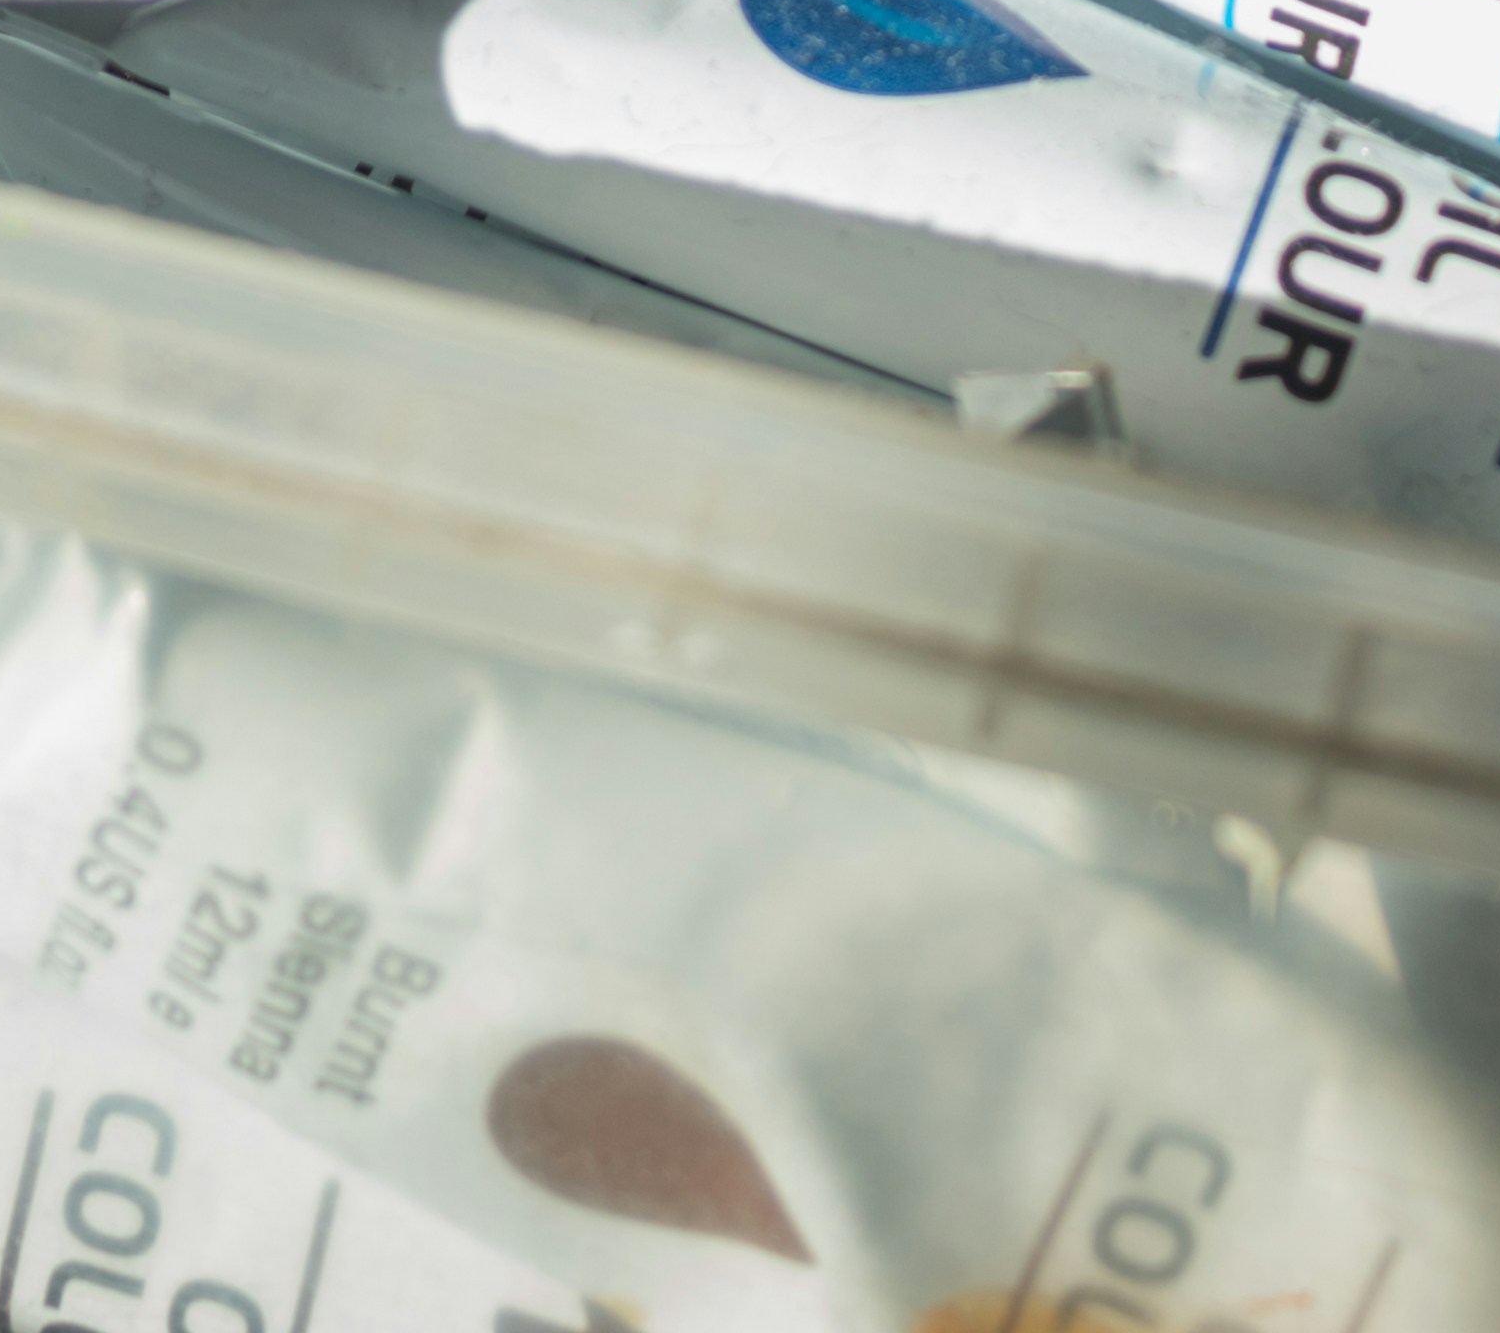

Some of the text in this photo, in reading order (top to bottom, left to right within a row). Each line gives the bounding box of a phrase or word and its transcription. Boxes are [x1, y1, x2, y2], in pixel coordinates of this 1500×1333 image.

[72, 721, 207, 911] 0.4US
[146, 862, 274, 1032] 12ml e
[226, 890, 371, 1086] Sienna
[310, 939, 444, 1112] Burnt
[41, 1089, 181, 1333] COL
